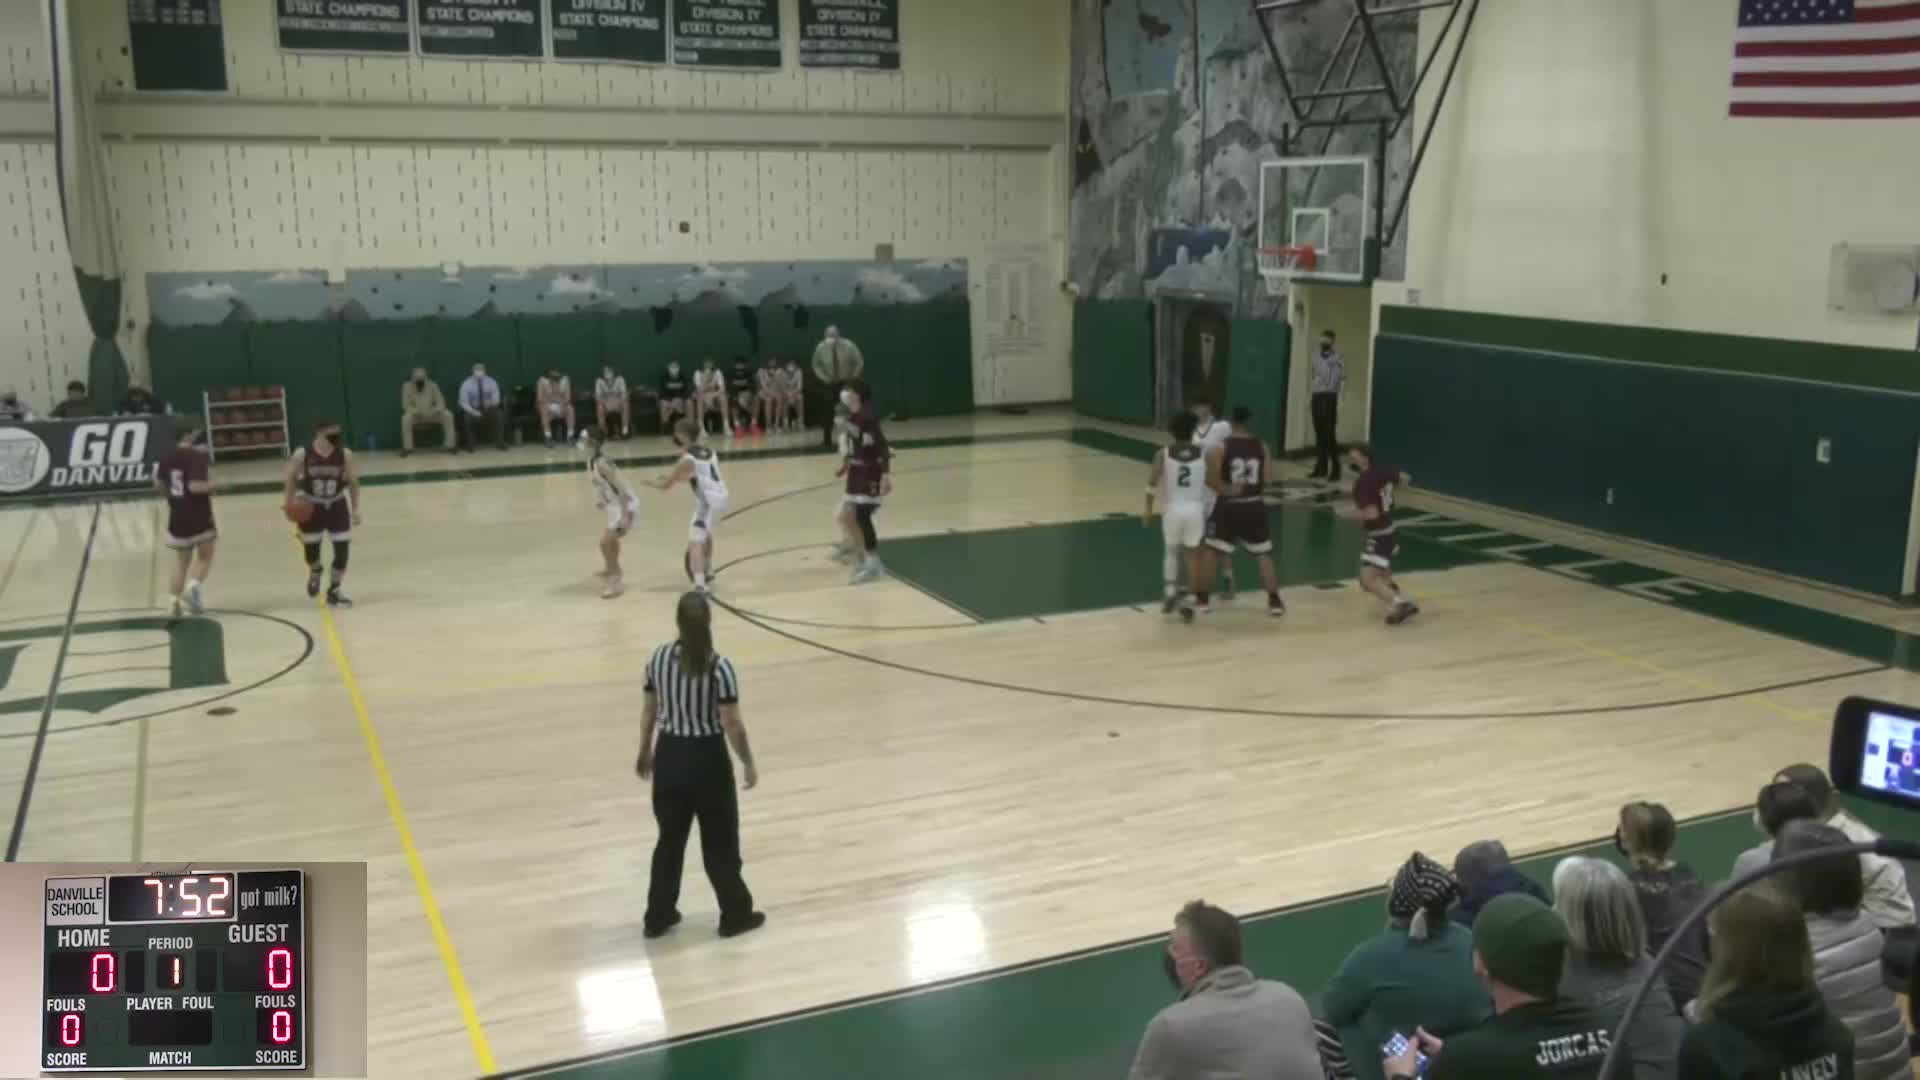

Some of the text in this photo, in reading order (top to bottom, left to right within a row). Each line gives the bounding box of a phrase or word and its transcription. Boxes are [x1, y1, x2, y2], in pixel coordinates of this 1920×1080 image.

[329, 4, 400, 19] CHAMPIONS
[426, 7, 534, 24] STATE CHAMPIONS
[560, 13, 659, 31] STATE CHAMPIONS
[680, 22, 774, 38] STATE CHAMPIONS
[69, 421, 149, 465] GO
[1176, 465, 1192, 487] 2
[1231, 458, 1260, 486] 23
[170, 470, 185, 497] 5
